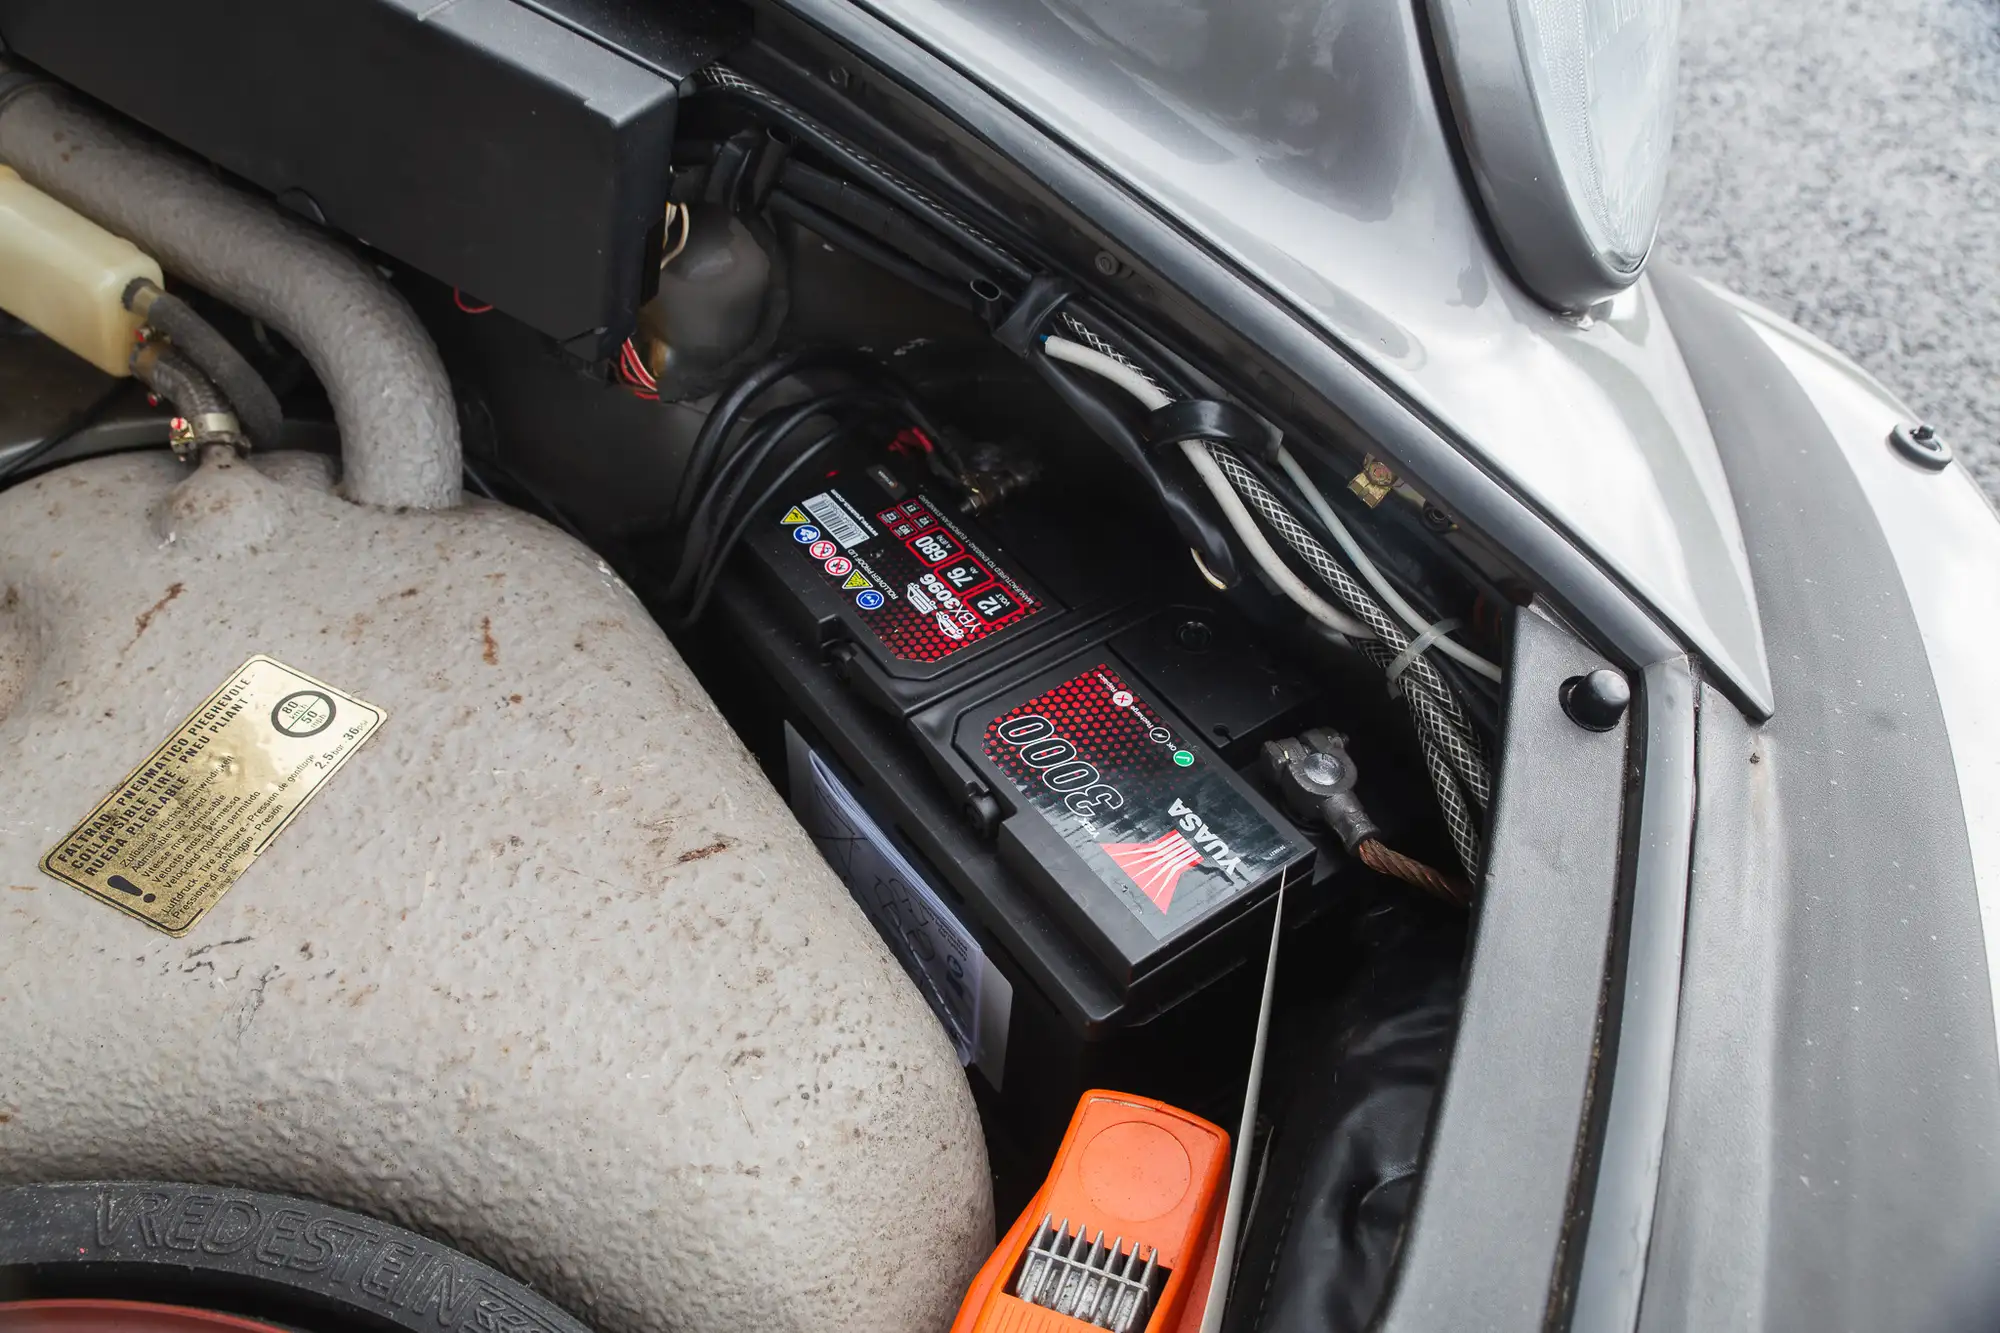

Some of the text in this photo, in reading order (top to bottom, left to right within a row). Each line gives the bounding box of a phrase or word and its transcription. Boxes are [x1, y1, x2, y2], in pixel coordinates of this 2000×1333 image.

[829, 488, 878, 536] www.yuasa.com
[918, 493, 942, 517] STANDARD
[939, 515, 967, 540] EUROPEAN
[914, 533, 948, 564] 680
[987, 560, 996, 568] TO
[847, 547, 898, 599] ROLLOVER PROOF LID
[946, 564, 973, 587] 76
[969, 565, 978, 574] Ah
[993, 566, 1034, 604] MANUFACTURED
[917, 571, 981, 633] YBX3096
[976, 595, 1002, 617] 12
[994, 592, 1010, 606] VOLT
[280, 700, 299, 714] 80
[288, 702, 308, 719] km/h
[300, 710, 318, 723] 50
[310, 713, 327, 728] mph
[1096, 672, 1176, 751] OK Recharge Replace
[56, 677, 251, 862] FALTRAD PNEUMATICO PIEGHEVOLE
[998, 712, 1122, 814] 3000
[69, 697, 249, 870] COLLAPSIBLE TIRE PNEU PLIANT
[83, 776, 189, 876] RUEDA PLEGLABLE
[204, 795, 240, 831] permessa
[130, 796, 208, 872] Admissible top speed
[141, 850, 172, 878] Vitesse
[187, 794, 226, 831] admissible
[160, 877, 198, 913] Luftdruck
[198, 857, 217, 873] Tire
[214, 826, 247, 858] pressure
[246, 791, 279, 821] Pression
[276, 782, 288, 791] de
[1166, 797, 1241, 875] YUASA
[162, 852, 201, 889] Velocidad
[172, 880, 211, 919] Pressione
[207, 872, 218, 881] di
[215, 835, 255, 873] gonfiaggio
[95, 1188, 480, 1326] VREDESTEIN
